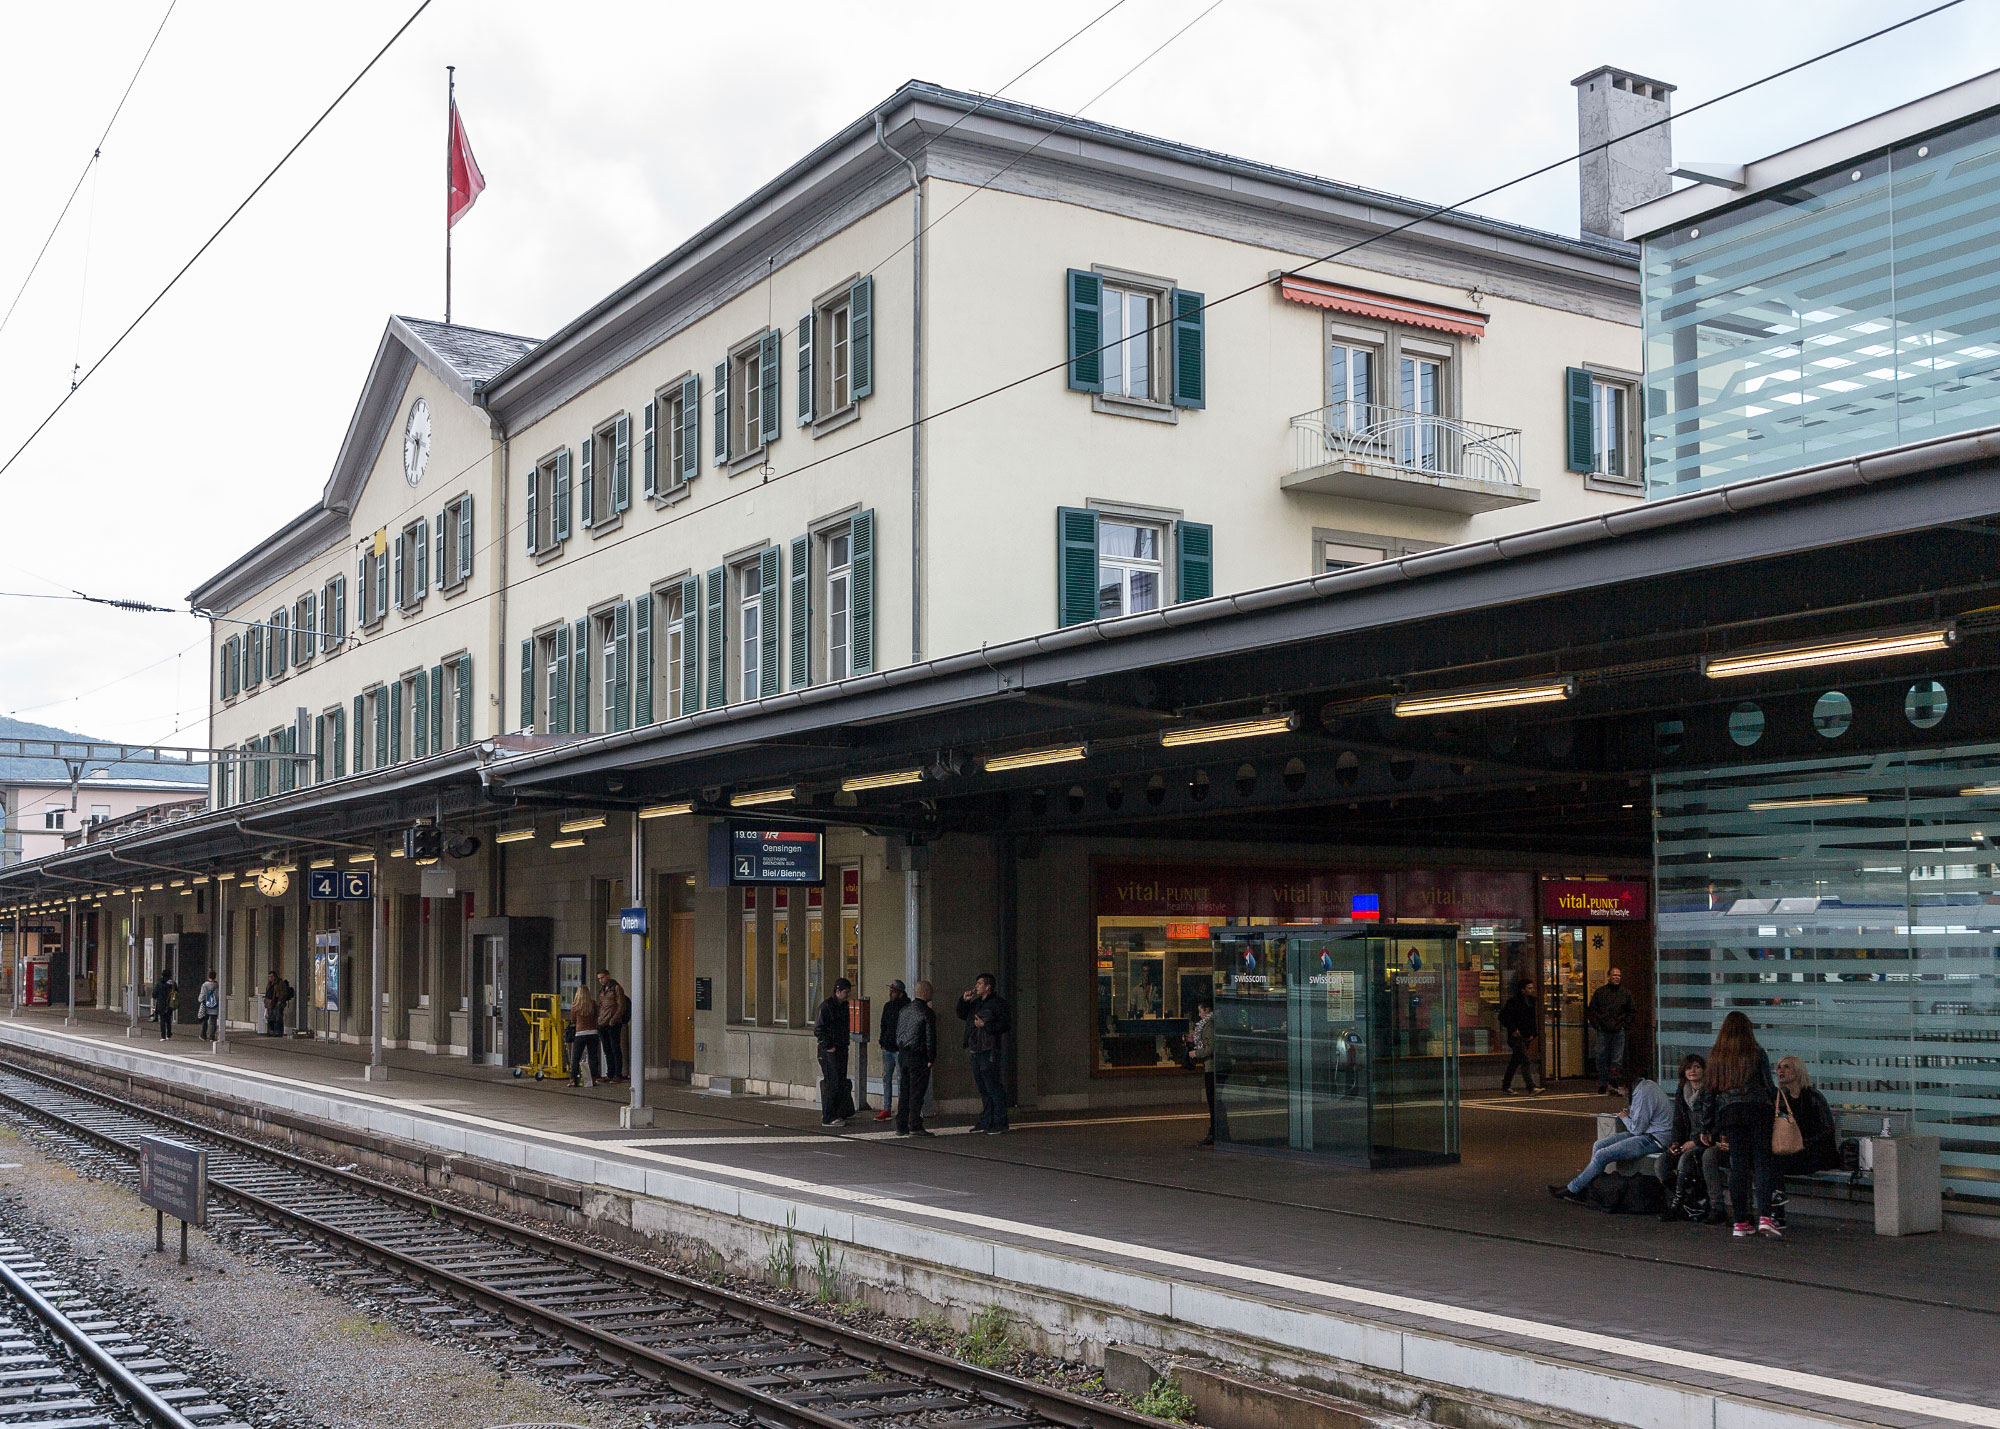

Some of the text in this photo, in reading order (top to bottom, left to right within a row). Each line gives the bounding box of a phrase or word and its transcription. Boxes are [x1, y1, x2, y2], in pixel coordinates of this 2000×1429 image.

[735, 831, 779, 840] 19.03 IR
[763, 844, 802, 854] Oensingen
[739, 861, 750, 876] 4
[763, 869, 806, 879] Biel/Bienne
[319, 880, 331, 895] 4
[350, 880, 363, 895] C
[1116, 881, 1210, 902] vital.PUNKT
[1558, 893, 1620, 909] vital.PUNKT
[1590, 908, 1630, 918] healthy lifestyle
[622, 917, 639, 929] Olten
[1234, 973, 1267, 984] swisscom
[1309, 974, 1345, 985] swisscom
[1395, 974, 1436, 985] swisscom
